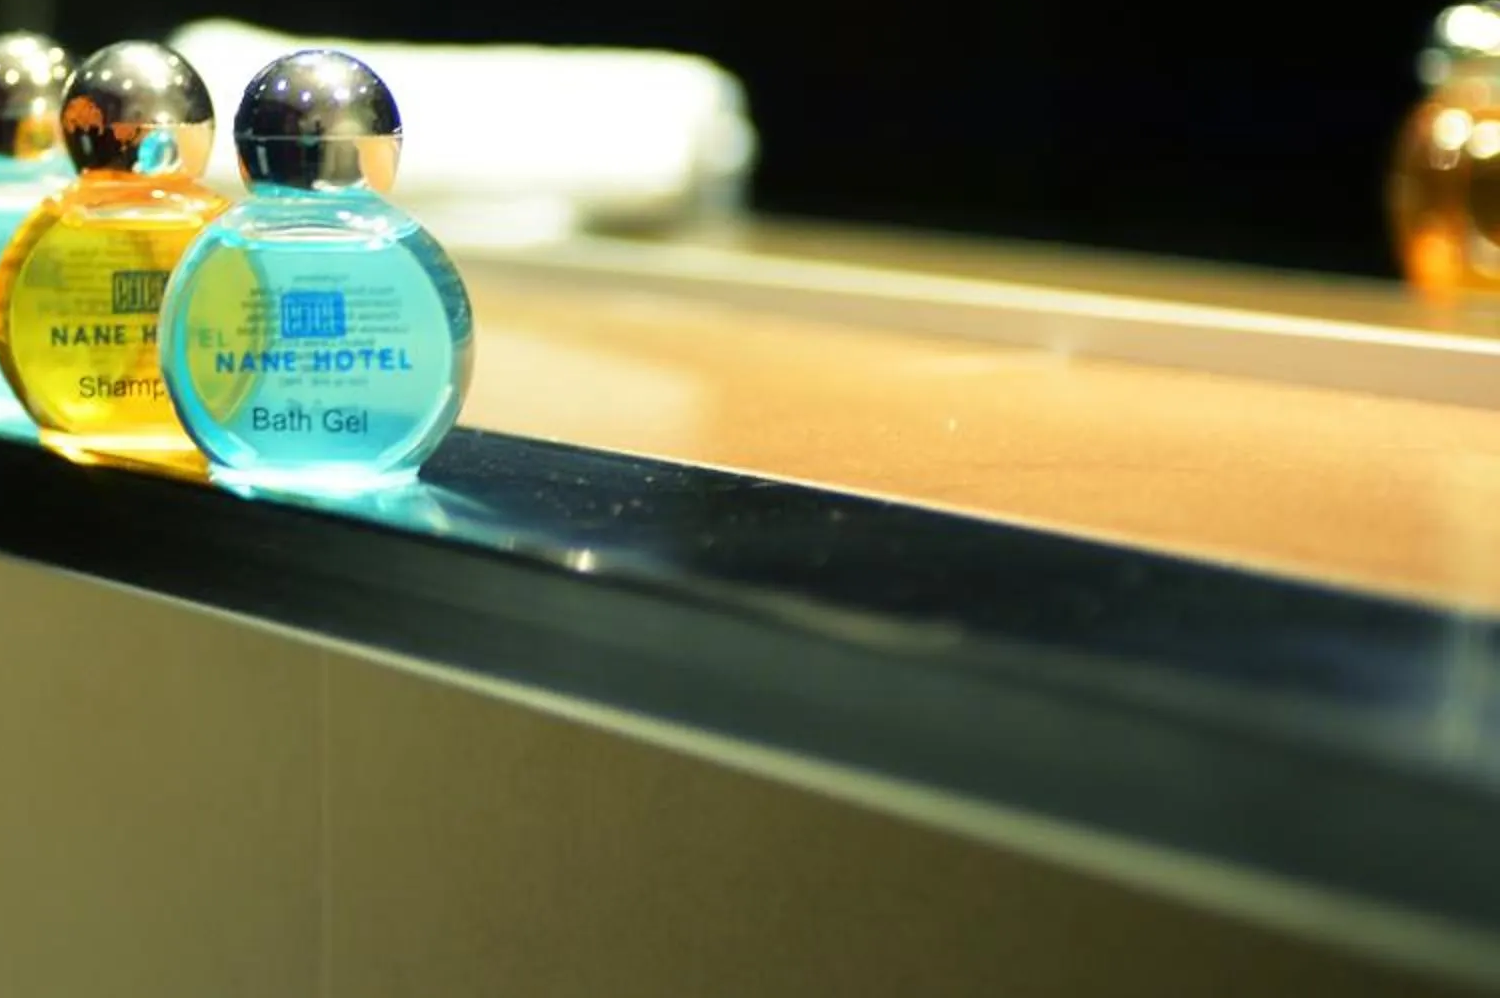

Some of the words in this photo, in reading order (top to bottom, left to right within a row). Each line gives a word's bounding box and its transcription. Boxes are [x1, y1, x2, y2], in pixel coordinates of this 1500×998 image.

[50, 324, 127, 347] NANE
[215, 350, 297, 373] NANE
[312, 347, 413, 372] HOTEL
[78, 374, 165, 402] Shamp
[251, 406, 312, 433] Bath
[322, 408, 369, 434] Gel
